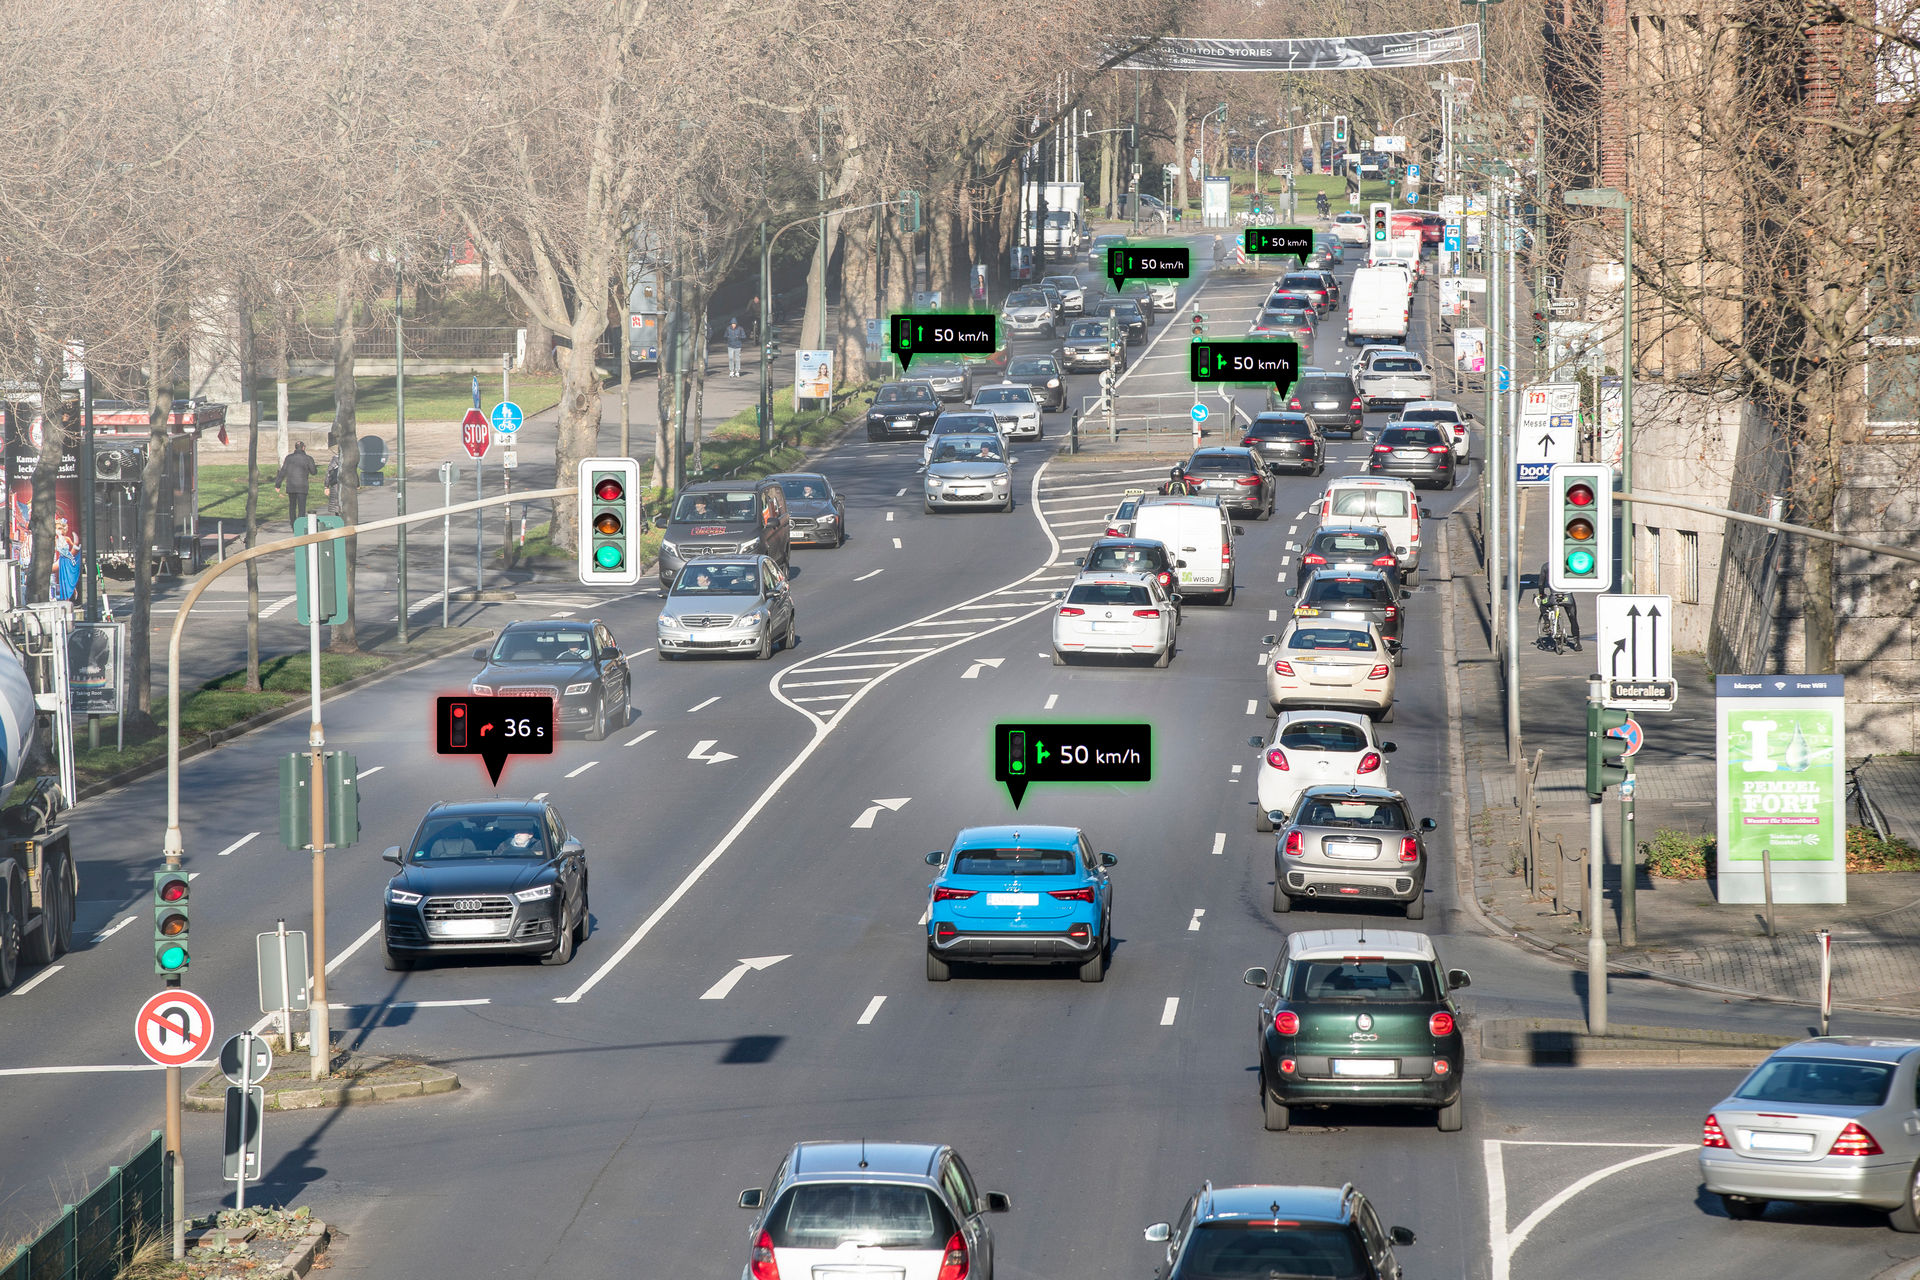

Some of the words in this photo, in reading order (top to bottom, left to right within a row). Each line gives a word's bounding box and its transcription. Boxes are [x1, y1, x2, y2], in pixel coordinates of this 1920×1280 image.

[1182, 47, 1225, 56] UNTOLD
[1228, 48, 1273, 58] STORIES
[1523, 420, 1547, 428] Messe
[464, 424, 488, 444] STOP
[1519, 464, 1549, 475] boot
[1616, 684, 1666, 697] Oederallee
[1733, 682, 1762, 690] bluespot
[1742, 720, 1778, 772] I
[1742, 781, 1820, 793] PEMPEL
[1742, 794, 1820, 813] FORT
